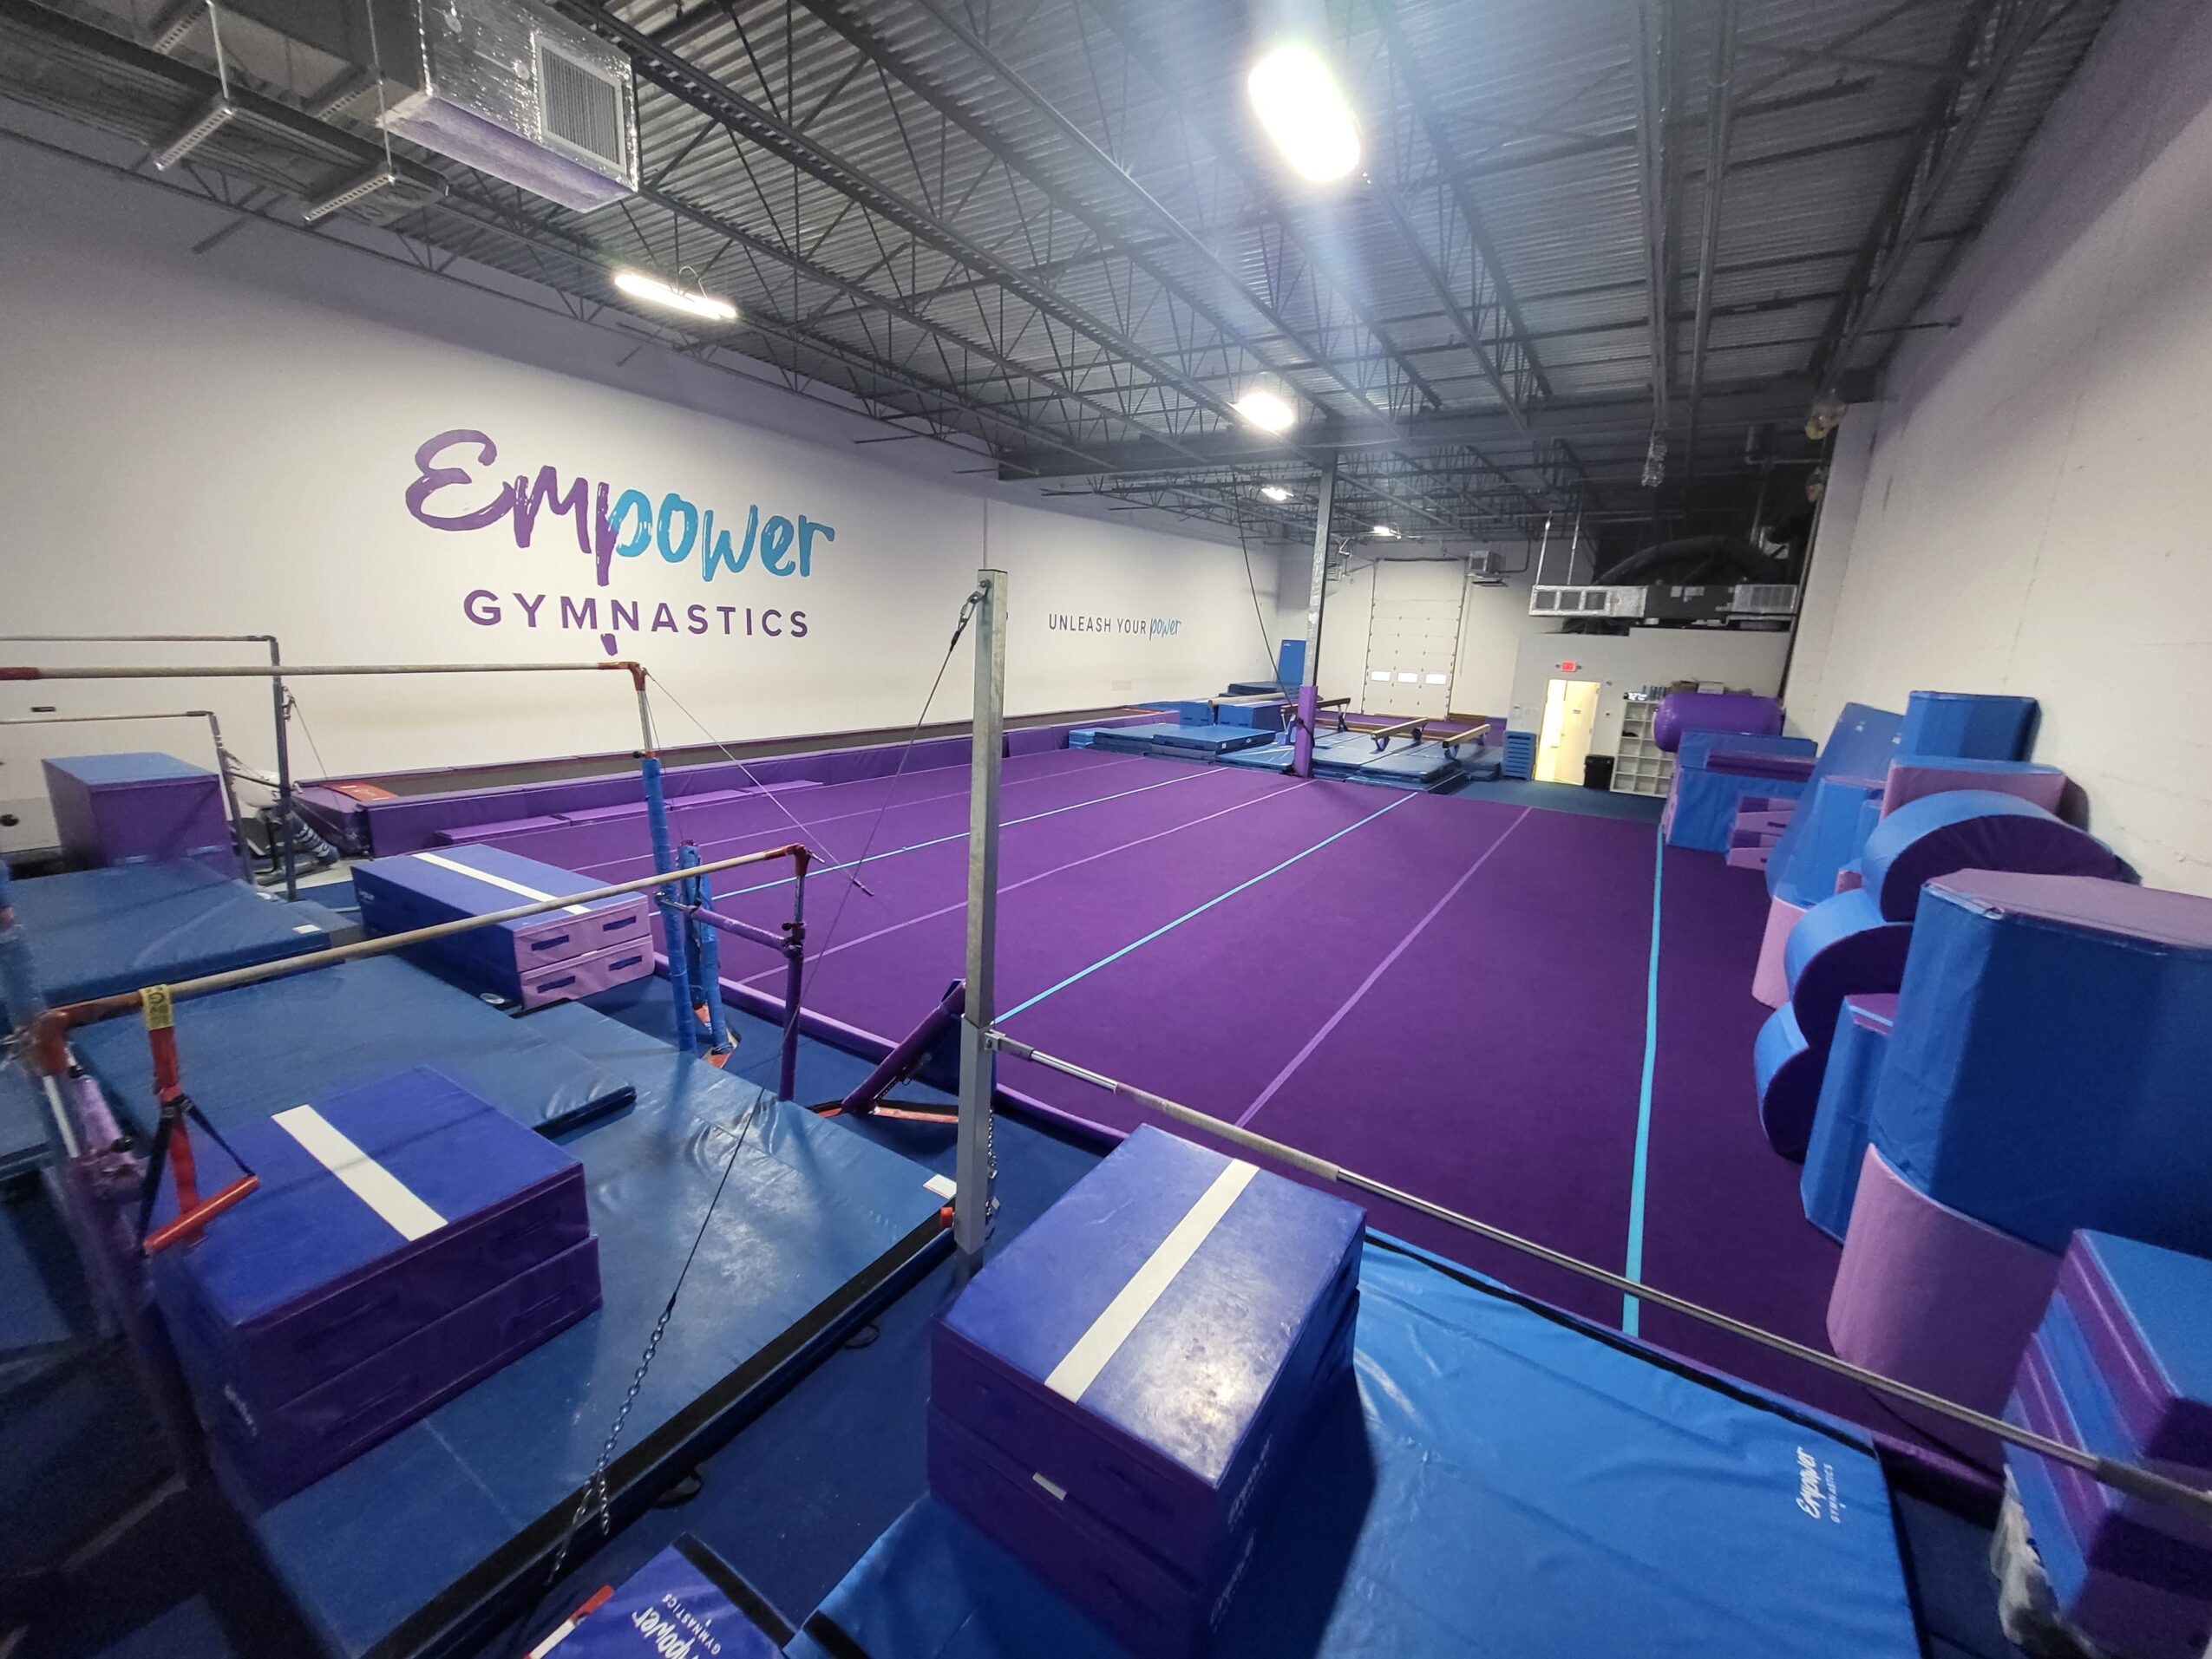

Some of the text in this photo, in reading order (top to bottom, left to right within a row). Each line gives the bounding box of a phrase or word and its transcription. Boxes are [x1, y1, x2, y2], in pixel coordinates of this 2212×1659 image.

[463, 589, 808, 637] GYMNASTICS
[1049, 613, 1181, 641] UNLEASH YOUR power
[631, 1606, 699, 1659] power
[662, 1593, 721, 1655] GYMNASTICS
